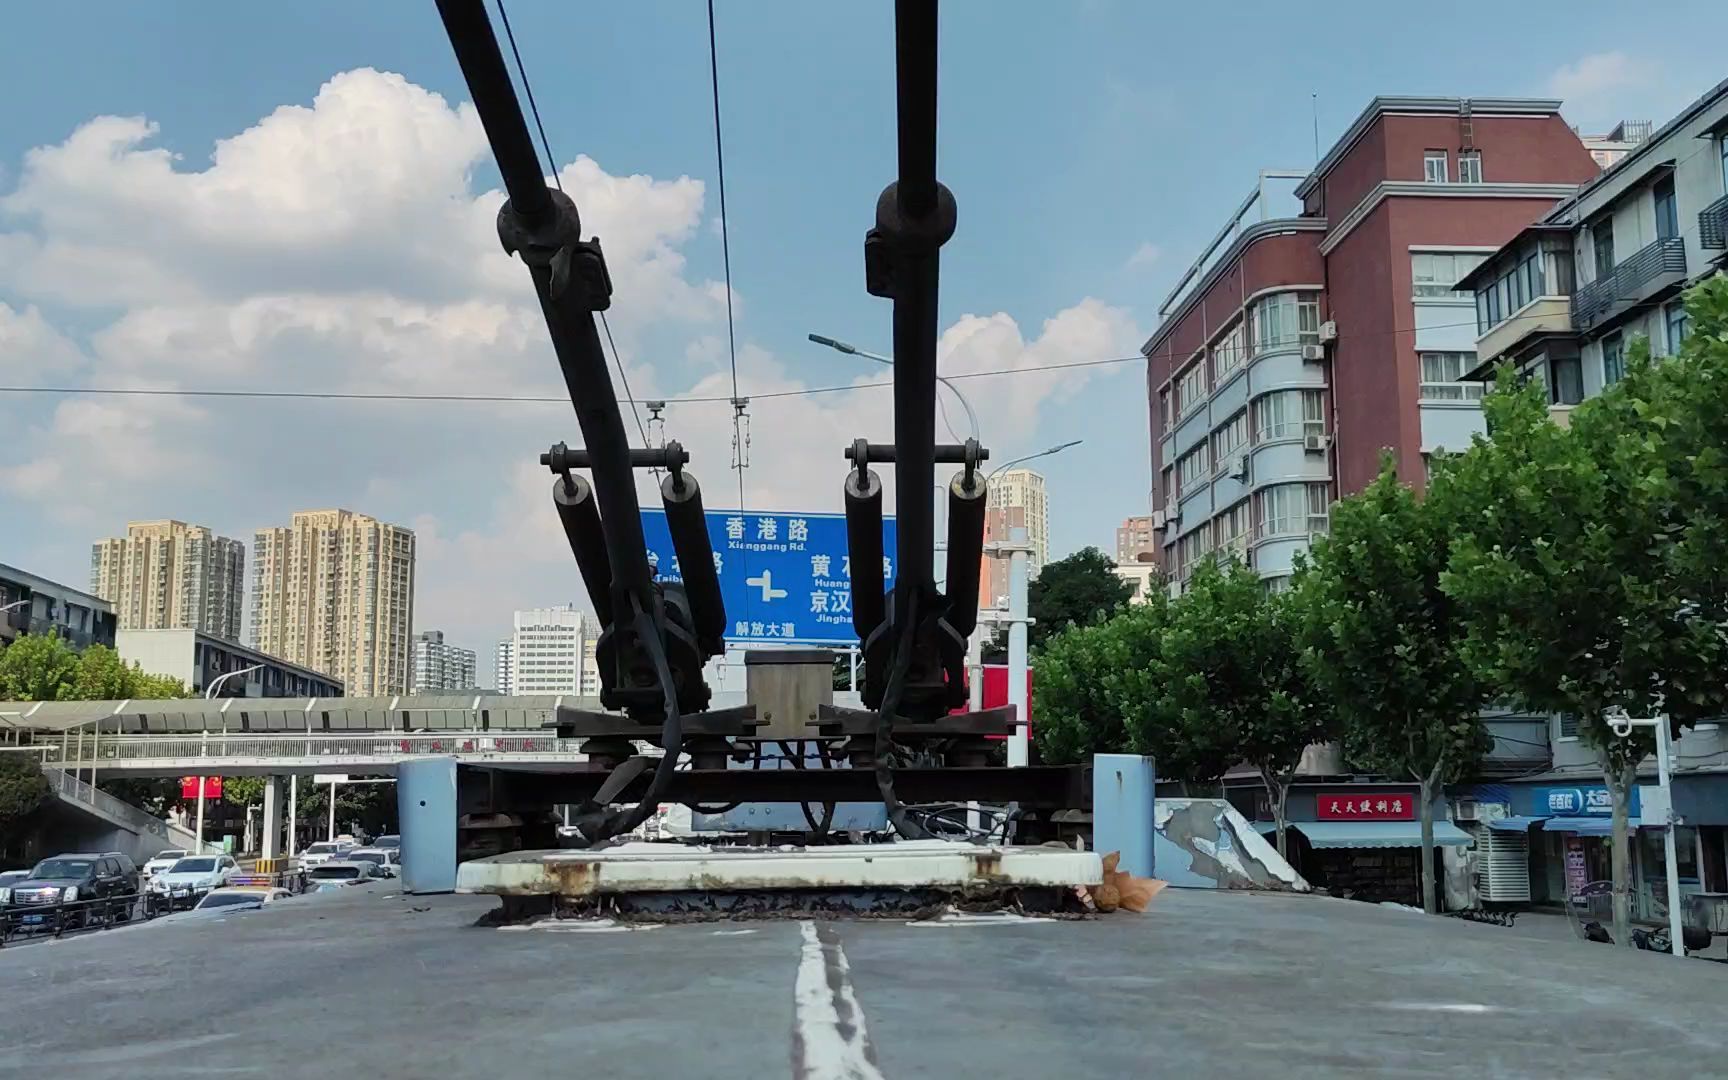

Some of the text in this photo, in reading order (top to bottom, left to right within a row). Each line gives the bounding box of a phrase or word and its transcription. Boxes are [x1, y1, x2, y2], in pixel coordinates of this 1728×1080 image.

[726, 517, 808, 541] 香港路
[728, 541, 807, 552] Xianggang Rd.
[810, 590, 851, 613] 京汉
[736, 621, 795, 637] 解放大道
[1330, 800, 1402, 814] 天天便利店
